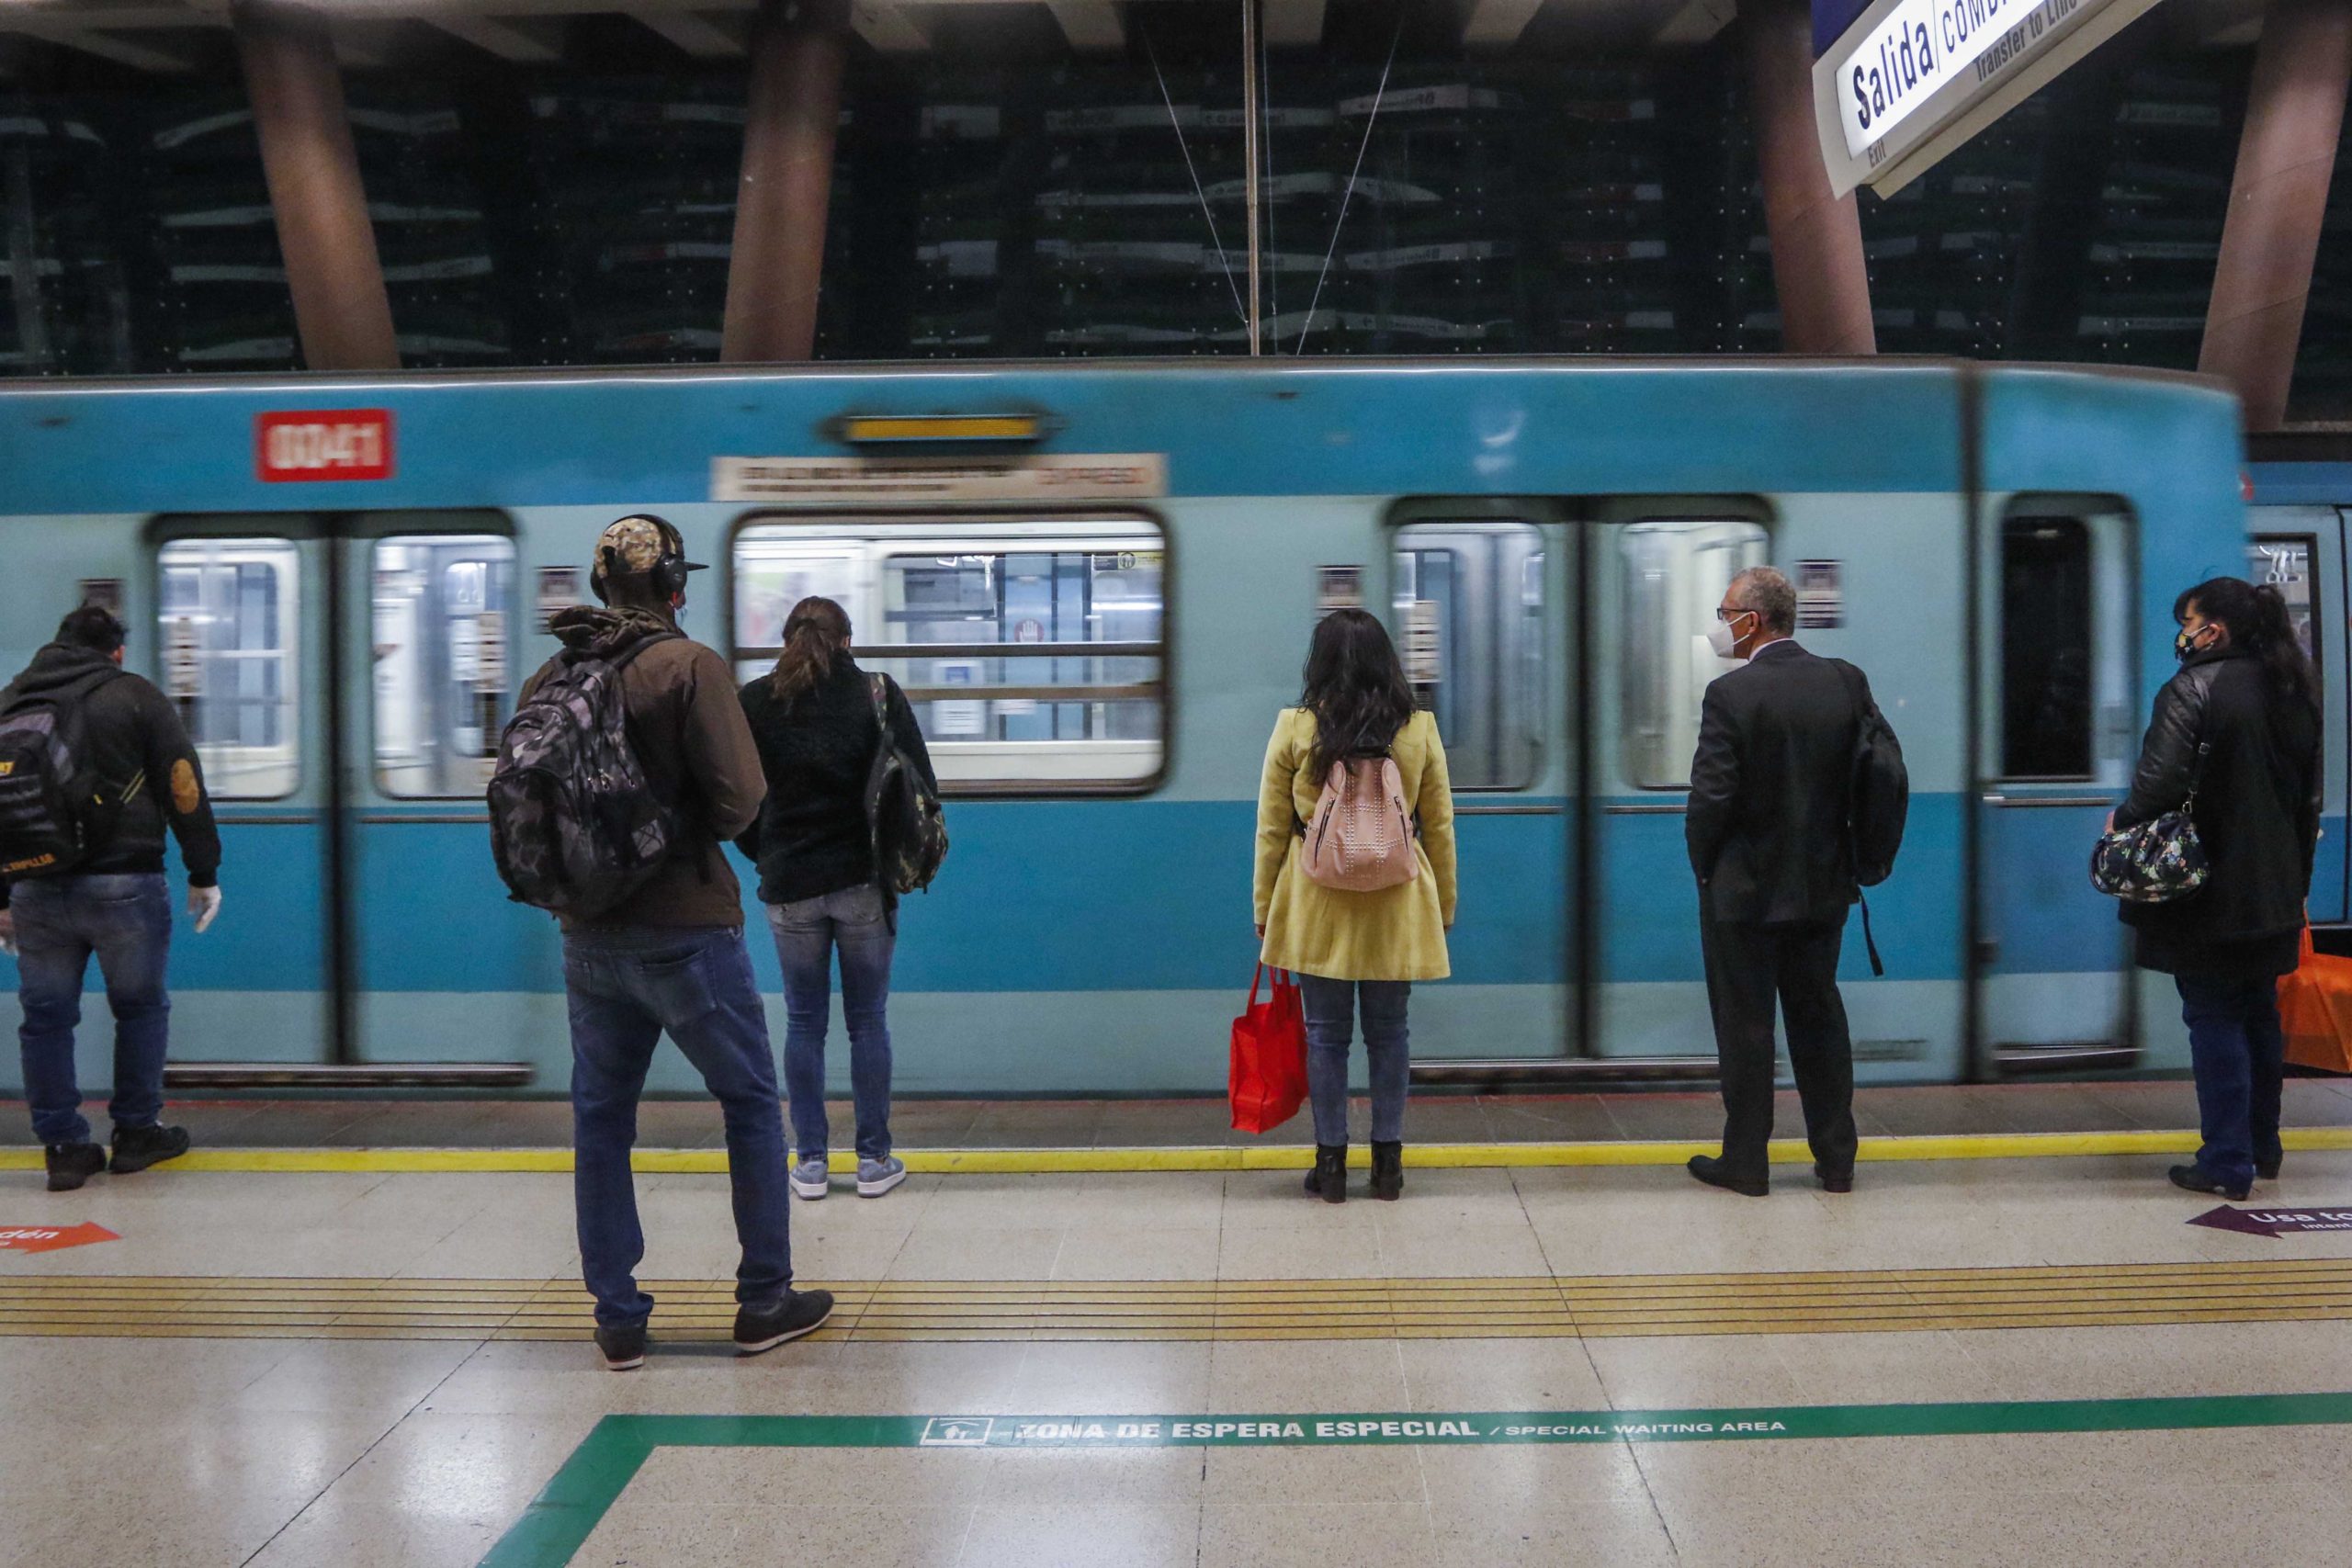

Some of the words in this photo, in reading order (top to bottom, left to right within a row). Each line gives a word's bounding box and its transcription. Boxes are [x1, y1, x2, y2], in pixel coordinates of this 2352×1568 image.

[1974, 26, 2027, 82] Transfer
[2028, 11, 2043, 39] to
[1853, 20, 1934, 130] Salida
[1868, 139, 1887, 169] Exit
[2247, 1213, 2316, 1223] Usa
[1015, 1423, 1105, 1438] ZONA
[1116, 1423, 1160, 1438] DE
[1171, 1422, 1305, 1438] ESPERA
[1316, 1421, 1479, 1438] ESPECIAL
[1505, 1426, 1606, 1436] SPECIAL
[1612, 1423, 1713, 1435] WAITING
[1720, 1421, 1786, 1432] AREA
